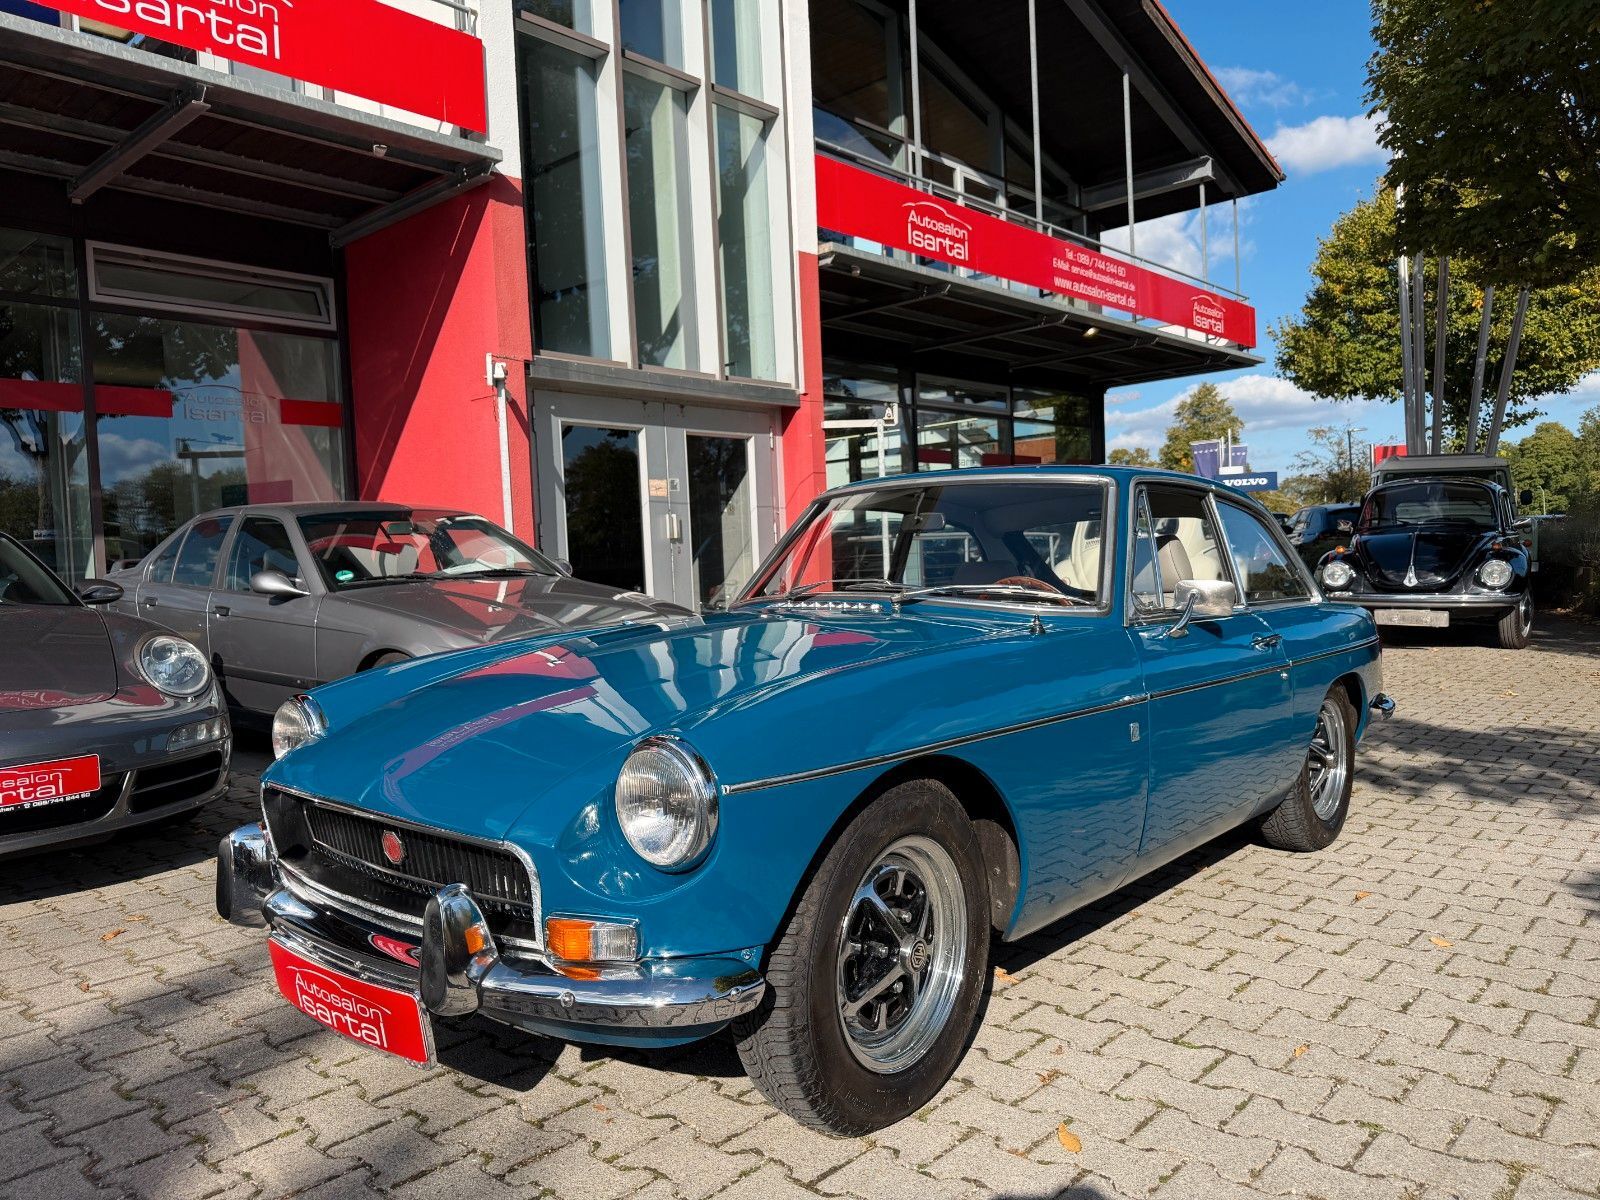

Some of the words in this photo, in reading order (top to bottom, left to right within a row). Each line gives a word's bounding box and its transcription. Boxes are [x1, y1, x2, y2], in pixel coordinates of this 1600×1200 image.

[908, 210, 968, 241] Autosalon
[908, 222, 968, 261] Isartal
[1053, 276, 1136, 309] www.autosalon-isartal.de
[1193, 301, 1224, 319] Autosalon
[1193, 311, 1224, 334] Isartal
[1222, 477, 1268, 487] VOLVO
[0, 772, 62, 789] salon
[0, 805, 14, 813] hen
[295, 973, 383, 1023] Autosalon
[296, 984, 387, 1048] Isartal
